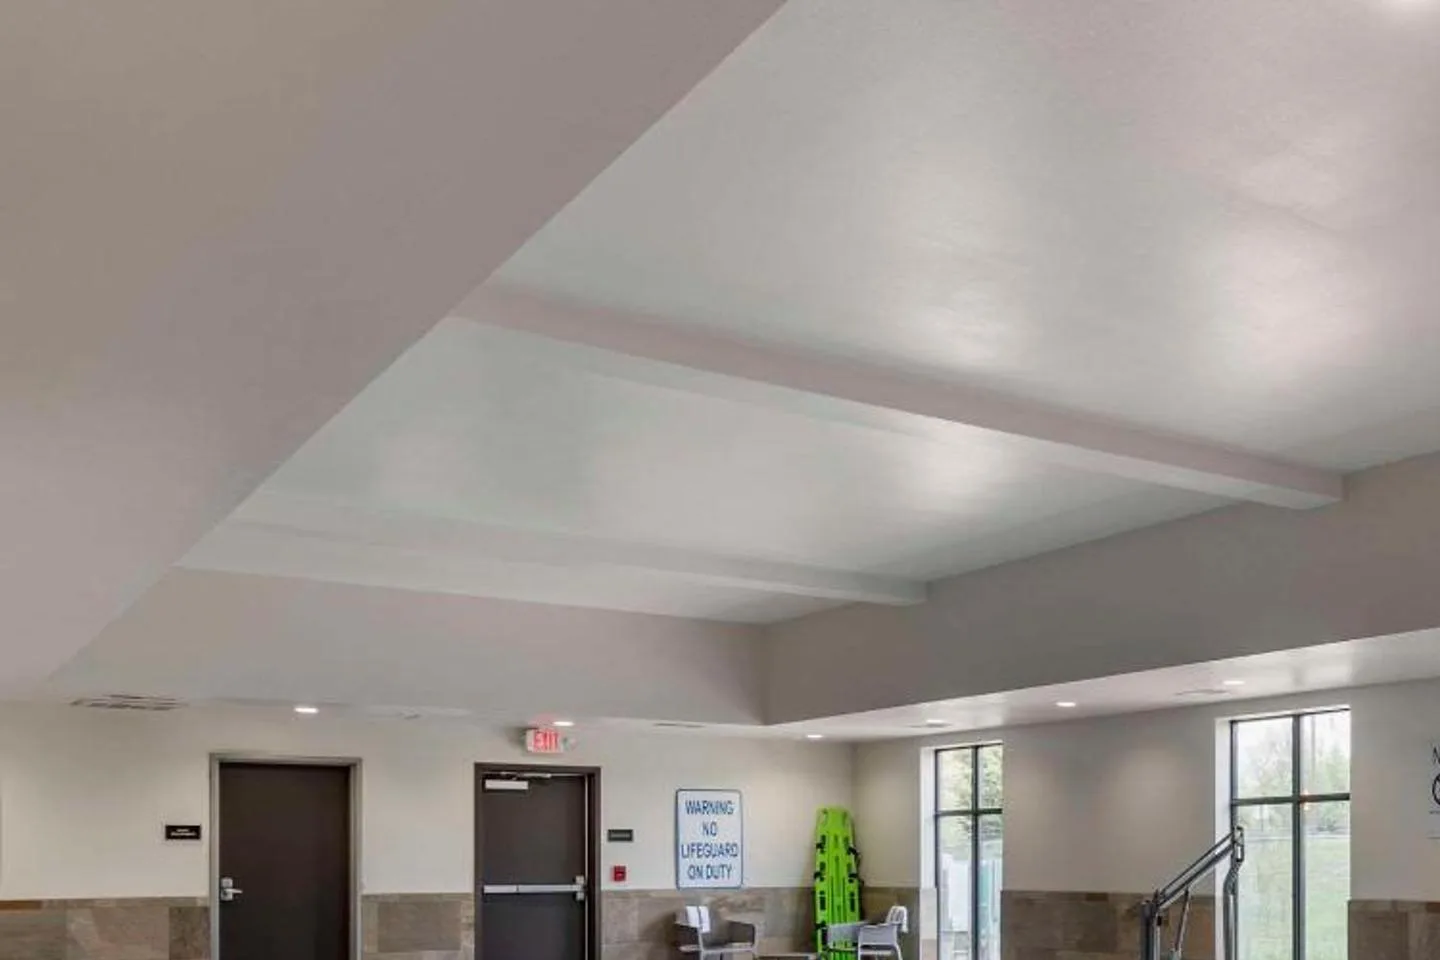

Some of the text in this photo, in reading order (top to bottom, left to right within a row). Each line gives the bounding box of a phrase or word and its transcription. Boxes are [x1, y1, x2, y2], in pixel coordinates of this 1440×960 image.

[534, 732, 559, 751] EXIT
[684, 800, 734, 815] WARNING
[702, 821, 718, 836] NO
[681, 842, 738, 859] LIFEGUARD
[687, 864, 733, 880] ON DUTY
